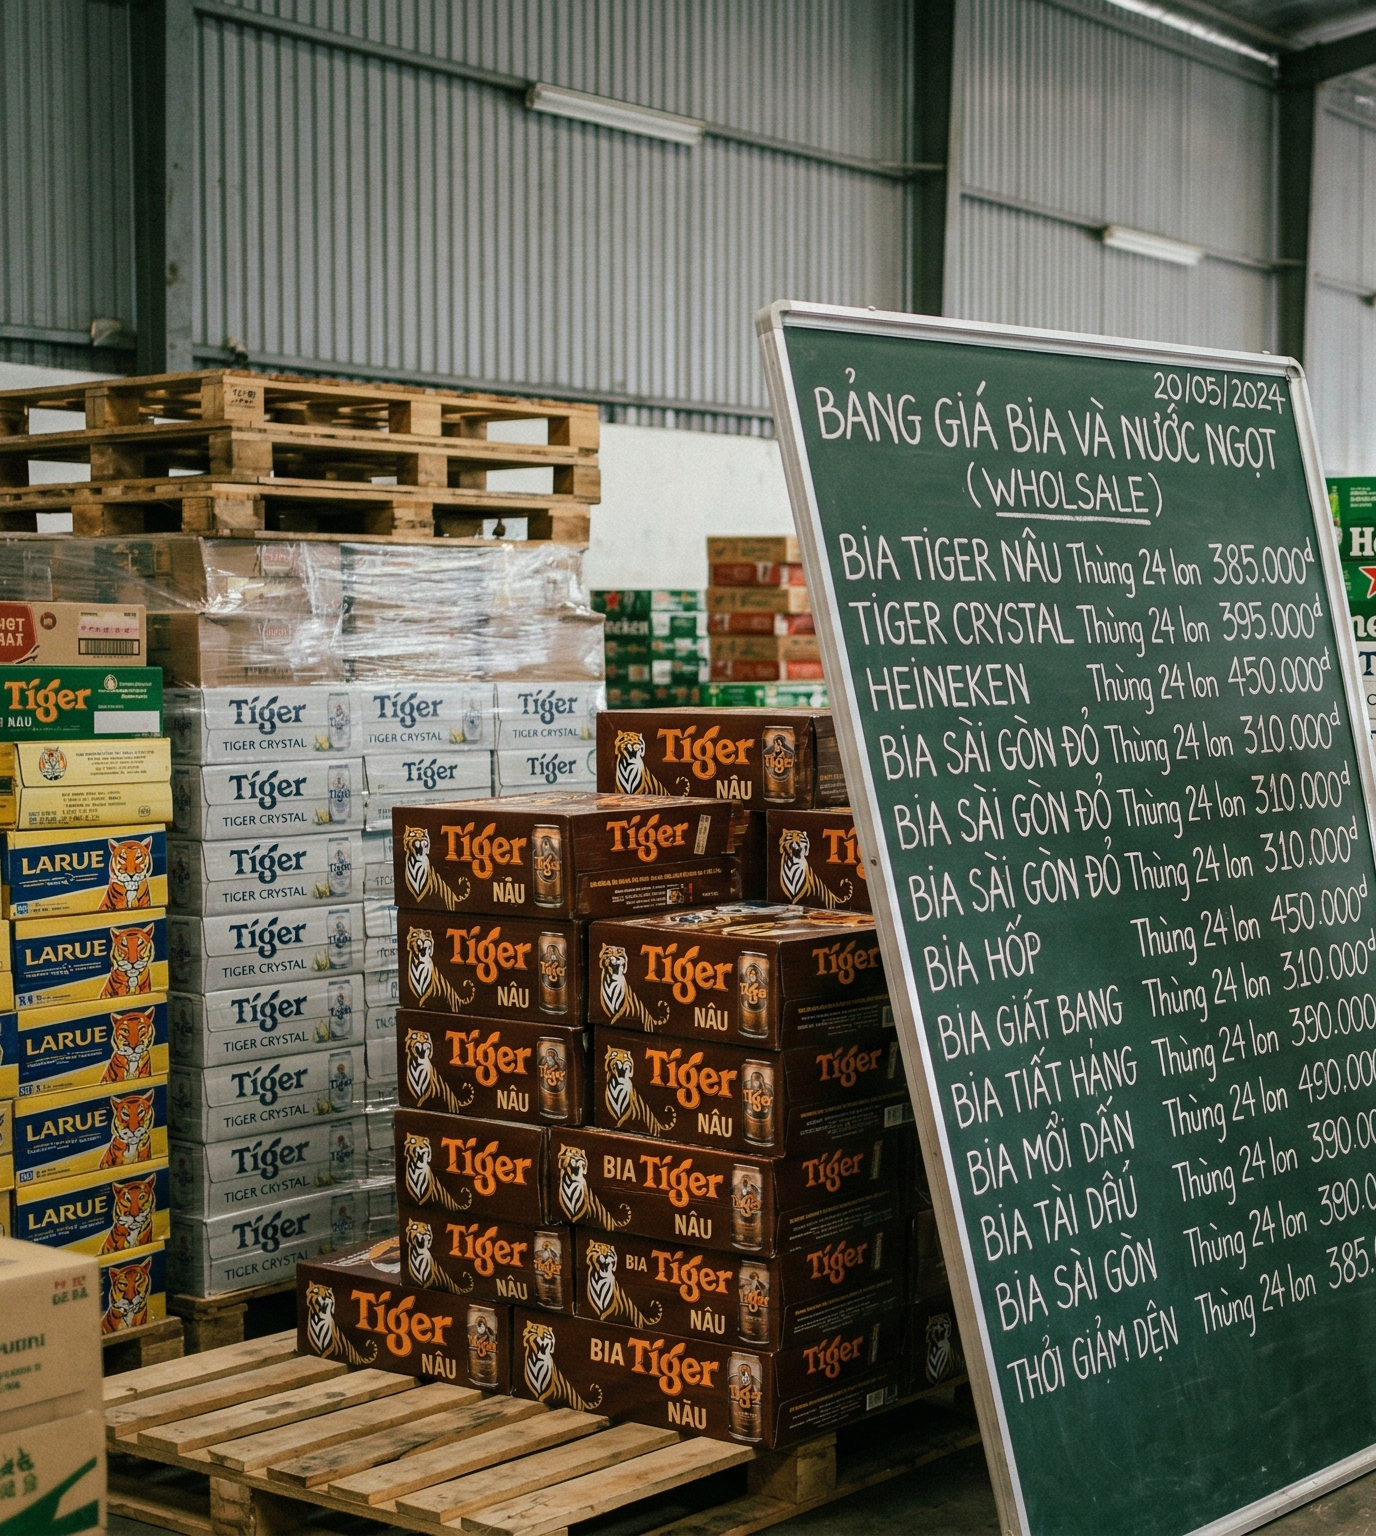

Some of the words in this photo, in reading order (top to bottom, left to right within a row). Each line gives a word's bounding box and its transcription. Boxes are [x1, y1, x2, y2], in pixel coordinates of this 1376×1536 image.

[1154, 370, 1285, 414] 20/05/2024
[814, 368, 921, 445] BẢNG
[1068, 397, 1115, 459] VÀ
[1121, 403, 1200, 463] NƯỚC
[1205, 423, 1276, 478] NGỌT
[967, 462, 1162, 511] (WHOLSALE)
[1001, 527, 1062, 583] NÂU
[1066, 542, 1135, 598] Thùng
[1139, 548, 1166, 585] 24
[1170, 548, 1202, 585] lon
[953, 602, 1074, 645] CRYSTAL
[1076, 605, 1145, 657] Thùng
[1149, 607, 1175, 644] 24
[1179, 605, 1210, 642] lon
[4, 678, 92, 723] Tiger
[229, 695, 307, 735] Tiger
[373, 692, 443, 728] Tiger
[1086, 663, 1154, 715] Thùng
[1158, 664, 1185, 699] 24
[1187, 662, 1219, 697] lon
[223, 740, 256, 751] TIGER
[259, 738, 307, 750] CRYSTAL
[657, 724, 755, 780] Tiger
[998, 715, 1057, 771] GÒN
[1061, 706, 1099, 767] ĐỎ
[1104, 725, 1170, 775] Thùng
[1173, 722, 1199, 760] 24
[1203, 721, 1234, 757] lon
[229, 770, 308, 810] Tiger
[716, 775, 752, 800] NÂU
[1012, 779, 1070, 837] GÒN
[1074, 772, 1111, 831] ĐỎ
[1116, 788, 1183, 839] Thùng
[1186, 784, 1212, 821] 24
[1215, 780, 1245, 818] lon
[223, 816, 256, 827] TIGER
[259, 813, 308, 825] CRYSTAL
[606, 814, 689, 863] Tiger
[21, 850, 105, 876] LARUE
[229, 843, 307, 884] Tiger
[440, 822, 527, 879] Tiger
[1023, 847, 1079, 905] GÒN
[1085, 836, 1121, 898] ĐỎ
[1124, 851, 1190, 901] Thùng
[1193, 845, 1220, 883] 24
[1223, 843, 1253, 878] lon
[222, 890, 256, 903] TIGER
[259, 886, 308, 901] CRYSTAL
[493, 876, 525, 904] NÂU
[25, 939, 107, 966] LARUE
[446, 925, 532, 984] Tiger
[1130, 916, 1197, 966] Thùng
[1201, 908, 1228, 947] 24
[1230, 905, 1260, 942] lon
[640, 942, 733, 1005] Tiger
[1057, 985, 1123, 1036] BANG
[1142, 976, 1208, 1023] Thùng
[1212, 967, 1237, 1004] 24
[1241, 962, 1270, 999] lon
[26, 1026, 108, 1056] LARUE
[694, 1002, 729, 1032] NÂU
[445, 1029, 532, 1087] Tiger
[1151, 1035, 1216, 1082] Thùng
[1219, 1024, 1245, 1063] 24
[1249, 1019, 1279, 1056] lon
[497, 1084, 529, 1112] NÂU
[645, 1047, 738, 1110] Tiger
[26, 1109, 108, 1142] LARUE
[1080, 1096, 1134, 1163] DẤN
[1162, 1094, 1226, 1143] Thùng
[1230, 1081, 1256, 1121] 24
[1259, 1076, 1288, 1114] lon
[441, 1137, 532, 1197] Tiger
[603, 1155, 637, 1183] BIA
[639, 1154, 724, 1208] Tiger
[1033, 1184, 1078, 1244] TÀI
[1172, 1158, 1236, 1205] Thùng
[1239, 1141, 1266, 1183] 24
[1269, 1137, 1298, 1175] lon
[28, 1195, 109, 1230] LARUE
[674, 1211, 713, 1240] NÂU
[445, 1223, 528, 1278] Tiger
[1104, 1232, 1157, 1293] GÒN
[1183, 1223, 1246, 1270] Thùng
[1249, 1206, 1275, 1247] 24
[1278, 1200, 1307, 1239] lon
[625, 1254, 648, 1273] BIA
[651, 1249, 734, 1303] Tiger
[1194, 1287, 1256, 1337] Thùng
[1260, 1270, 1285, 1312] 24
[1288, 1264, 1316, 1302] lon
[351, 1289, 453, 1358] Tiger
[627, 1336, 721, 1397] Tiger
